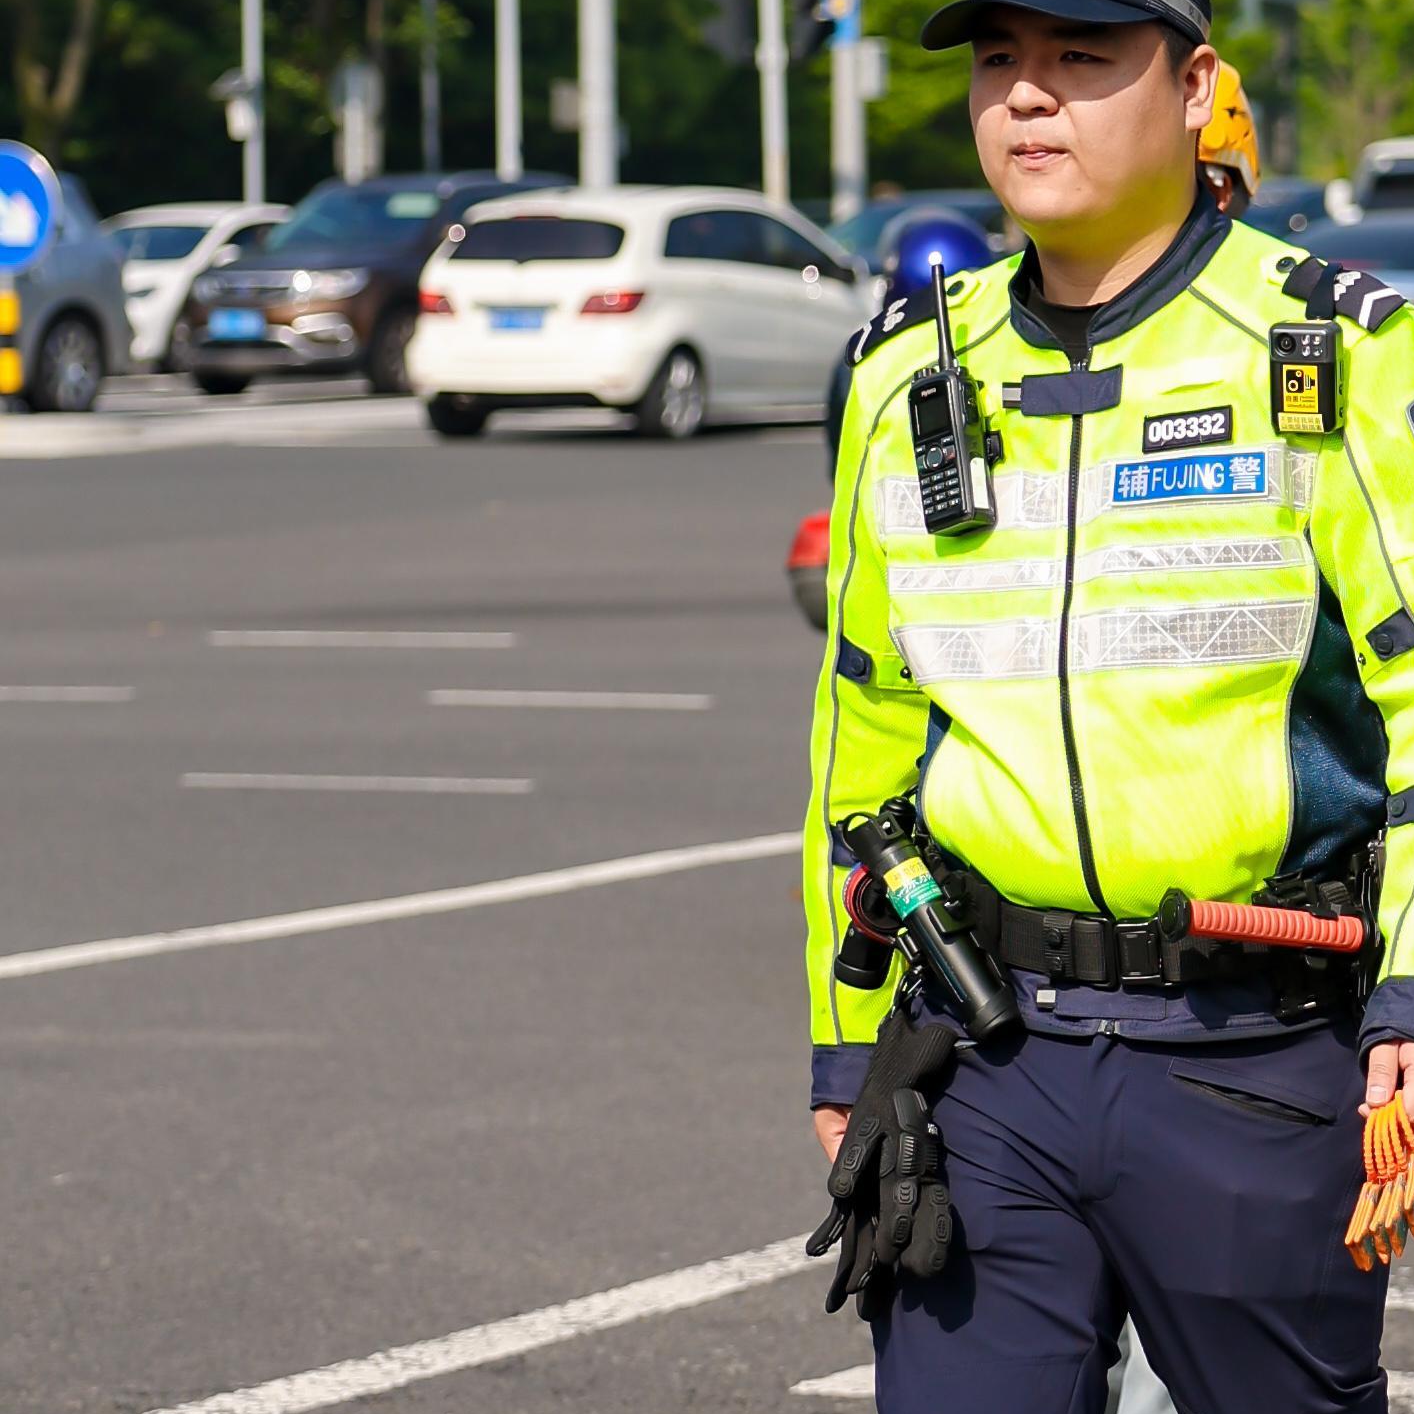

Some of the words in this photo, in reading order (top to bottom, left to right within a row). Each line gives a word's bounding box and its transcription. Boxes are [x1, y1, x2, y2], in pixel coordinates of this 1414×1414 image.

[1148, 412, 1226, 443] 003332
[1117, 465, 1151, 499] 辅
[1151, 461, 1225, 493] FUJING
[1228, 456, 1262, 491] 警
